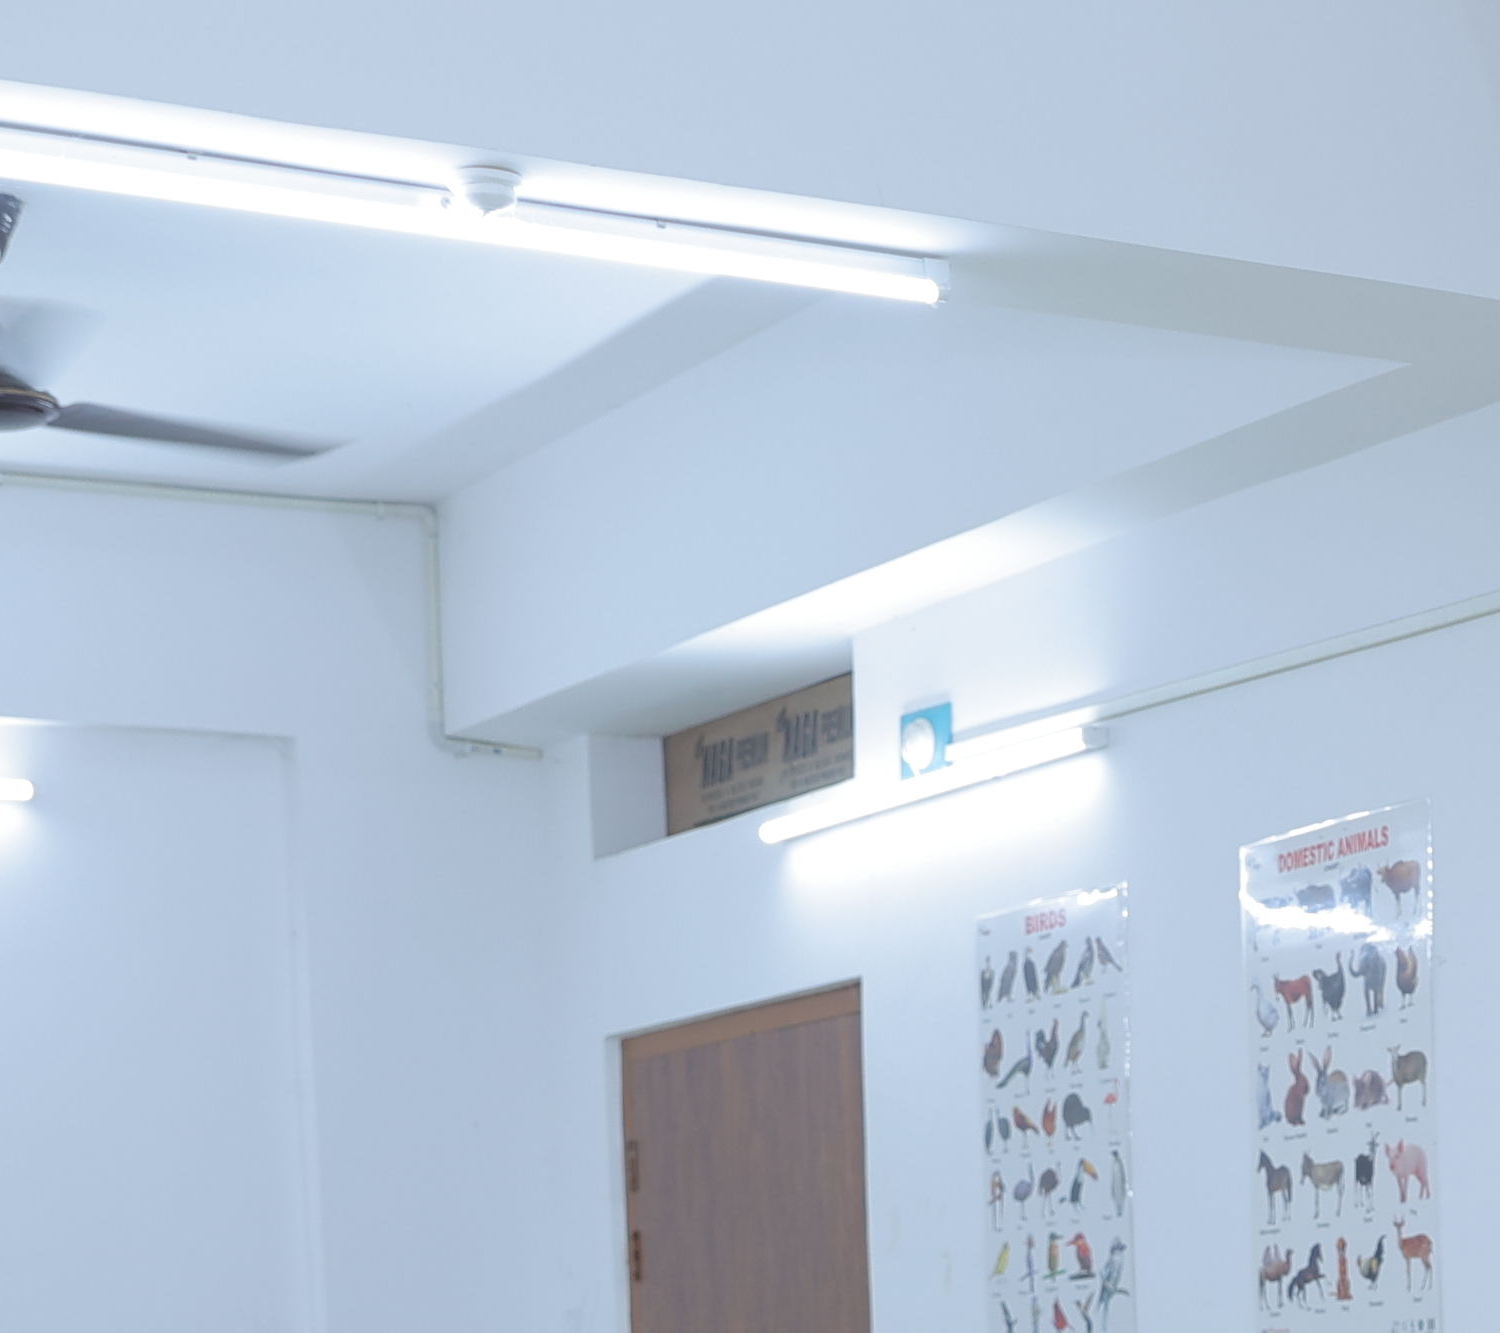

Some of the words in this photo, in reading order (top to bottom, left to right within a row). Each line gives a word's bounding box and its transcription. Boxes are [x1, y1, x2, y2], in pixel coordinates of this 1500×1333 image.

[1277, 840, 1336, 874] DOMESTIC
[1337, 825, 1390, 858] ANIMALS
[1025, 908, 1067, 935] BIRDS
